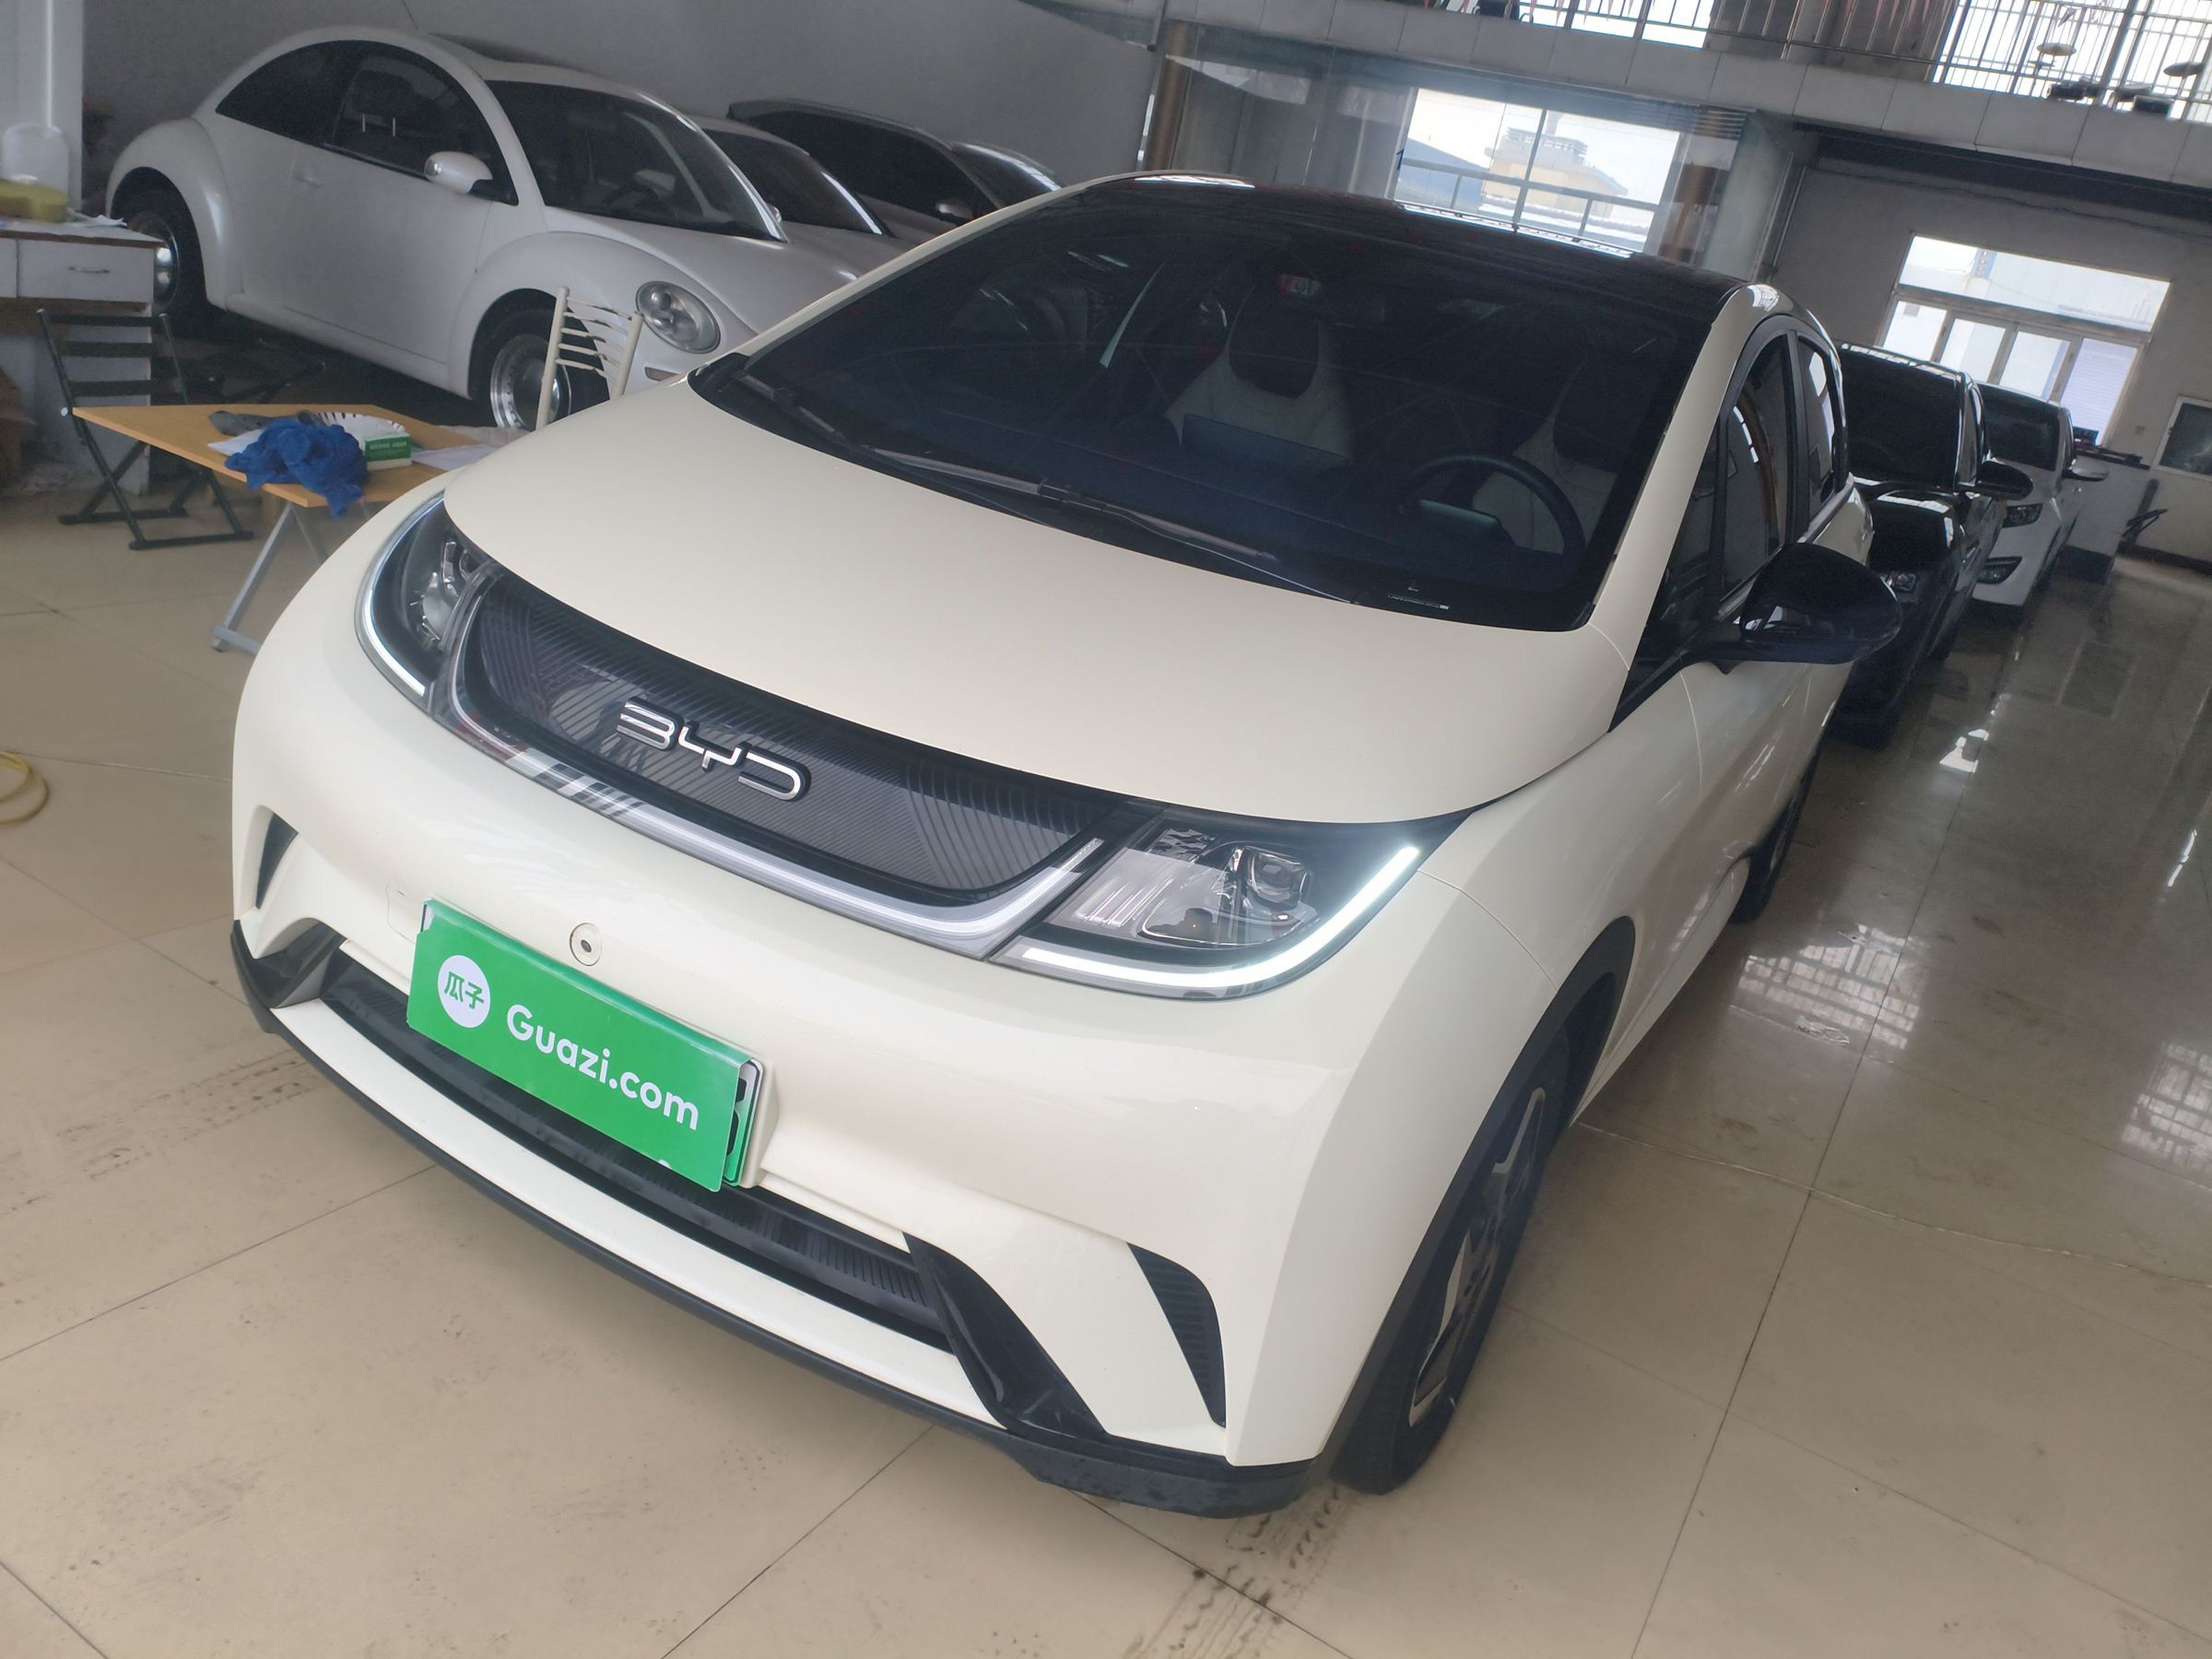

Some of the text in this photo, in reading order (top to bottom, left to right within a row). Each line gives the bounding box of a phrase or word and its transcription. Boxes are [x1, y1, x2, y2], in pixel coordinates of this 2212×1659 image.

[616, 702, 802, 801] BYD
[444, 971, 484, 1009] 瓜子
[507, 1004, 699, 1130] Guazi.com
